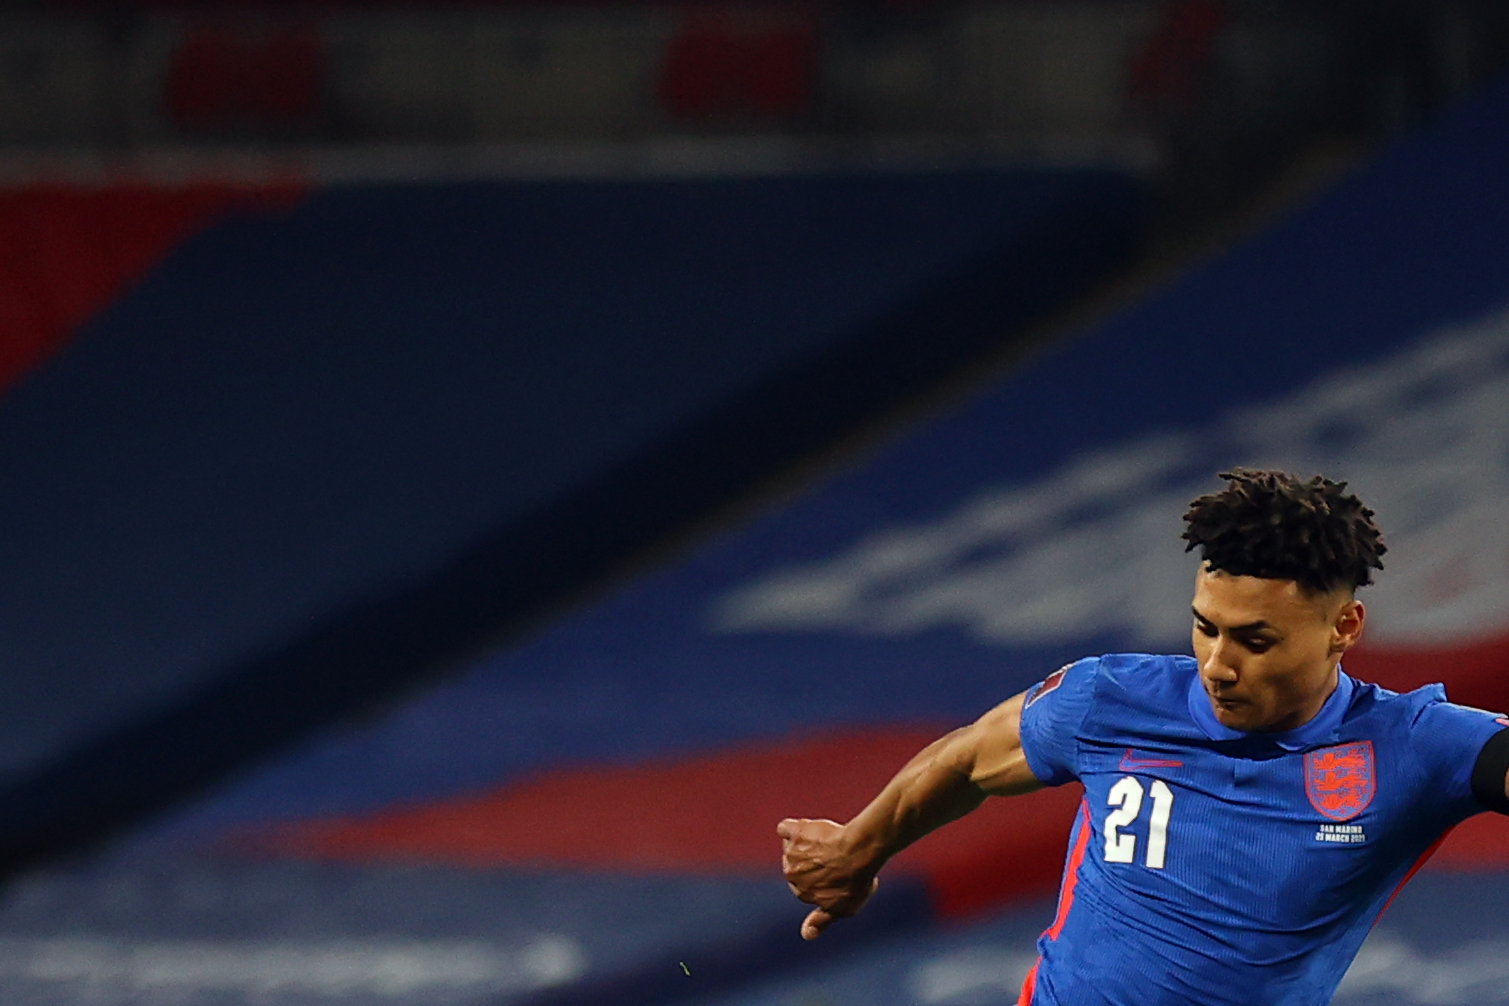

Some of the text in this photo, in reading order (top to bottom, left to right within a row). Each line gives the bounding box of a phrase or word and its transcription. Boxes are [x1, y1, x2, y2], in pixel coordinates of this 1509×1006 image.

[1103, 775, 1175, 870] 21
[1320, 824, 1363, 834] SAN MARINO
[1325, 833, 1350, 843] MARCH
